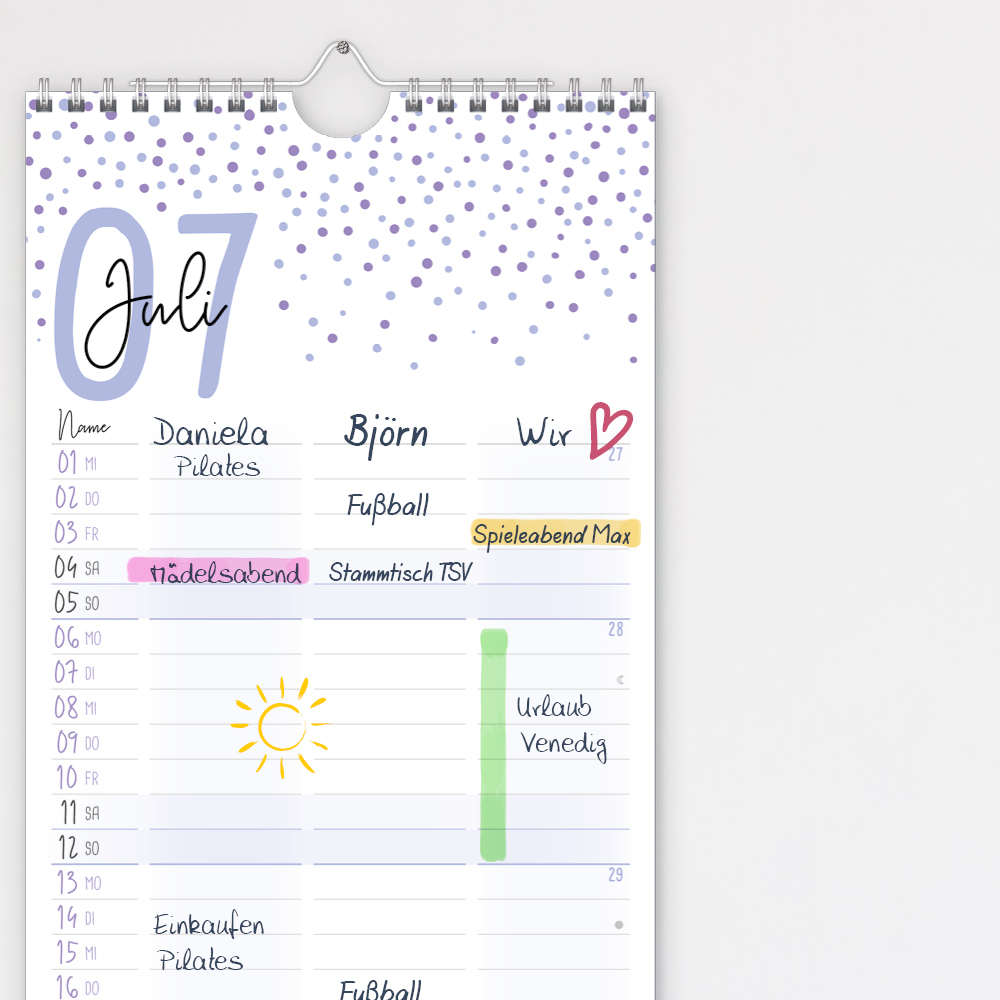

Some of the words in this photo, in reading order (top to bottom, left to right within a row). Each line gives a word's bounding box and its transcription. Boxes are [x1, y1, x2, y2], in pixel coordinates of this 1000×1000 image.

[53, 207, 258, 401] 07
[85, 252, 228, 369] Juli
[59, 409, 111, 440] Name
[154, 417, 268, 445] Daniela
[517, 417, 572, 446] Wir
[344, 414, 427, 461] Björn
[58, 449, 76, 475] 01
[84, 456, 97, 471] MI
[174, 453, 260, 476] Pilates
[607, 445, 625, 463] 27
[56, 485, 78, 509] 02
[85, 491, 100, 507] DO
[348, 493, 428, 525] Fußball
[55, 520, 77, 544] 03
[85, 526, 99, 541] FR
[474, 524, 587, 553] Spieleabend
[593, 524, 630, 544] Max
[55, 555, 77, 578] 04
[84, 560, 100, 576] SA
[329, 562, 432, 582] Stammtisch
[439, 562, 473, 581] TSV
[55, 590, 79, 613] 05
[84, 595, 100, 611] SO
[55, 625, 79, 648] 06
[84, 630, 102, 646] MO
[608, 621, 624, 637] 28
[55, 660, 78, 683] 07
[85, 665, 95, 681] DI
[55, 695, 78, 719] 08
[84, 701, 97, 716] MI
[518, 694, 591, 717] Urlaub
[57, 730, 77, 753] 09
[85, 735, 100, 751] DO
[521, 732, 606, 764] Venedig
[57, 765, 77, 789] 10
[85, 770, 99, 786] FR
[60, 799, 77, 825] 11
[84, 805, 100, 821] SA
[59, 835, 78, 859] 12
[84, 840, 100, 856] SO
[58, 870, 77, 894] 13
[84, 875, 102, 891] MO
[608, 866, 624, 882] 29
[58, 905, 77, 929] 14
[85, 910, 95, 926] DI
[154, 909, 264, 939] Einkaufen
[57, 940, 78, 964] 15
[84, 946, 97, 961] MI
[157, 947, 243, 970] Pilates
[57, 975, 78, 999] 16
[85, 980, 100, 996] DO
